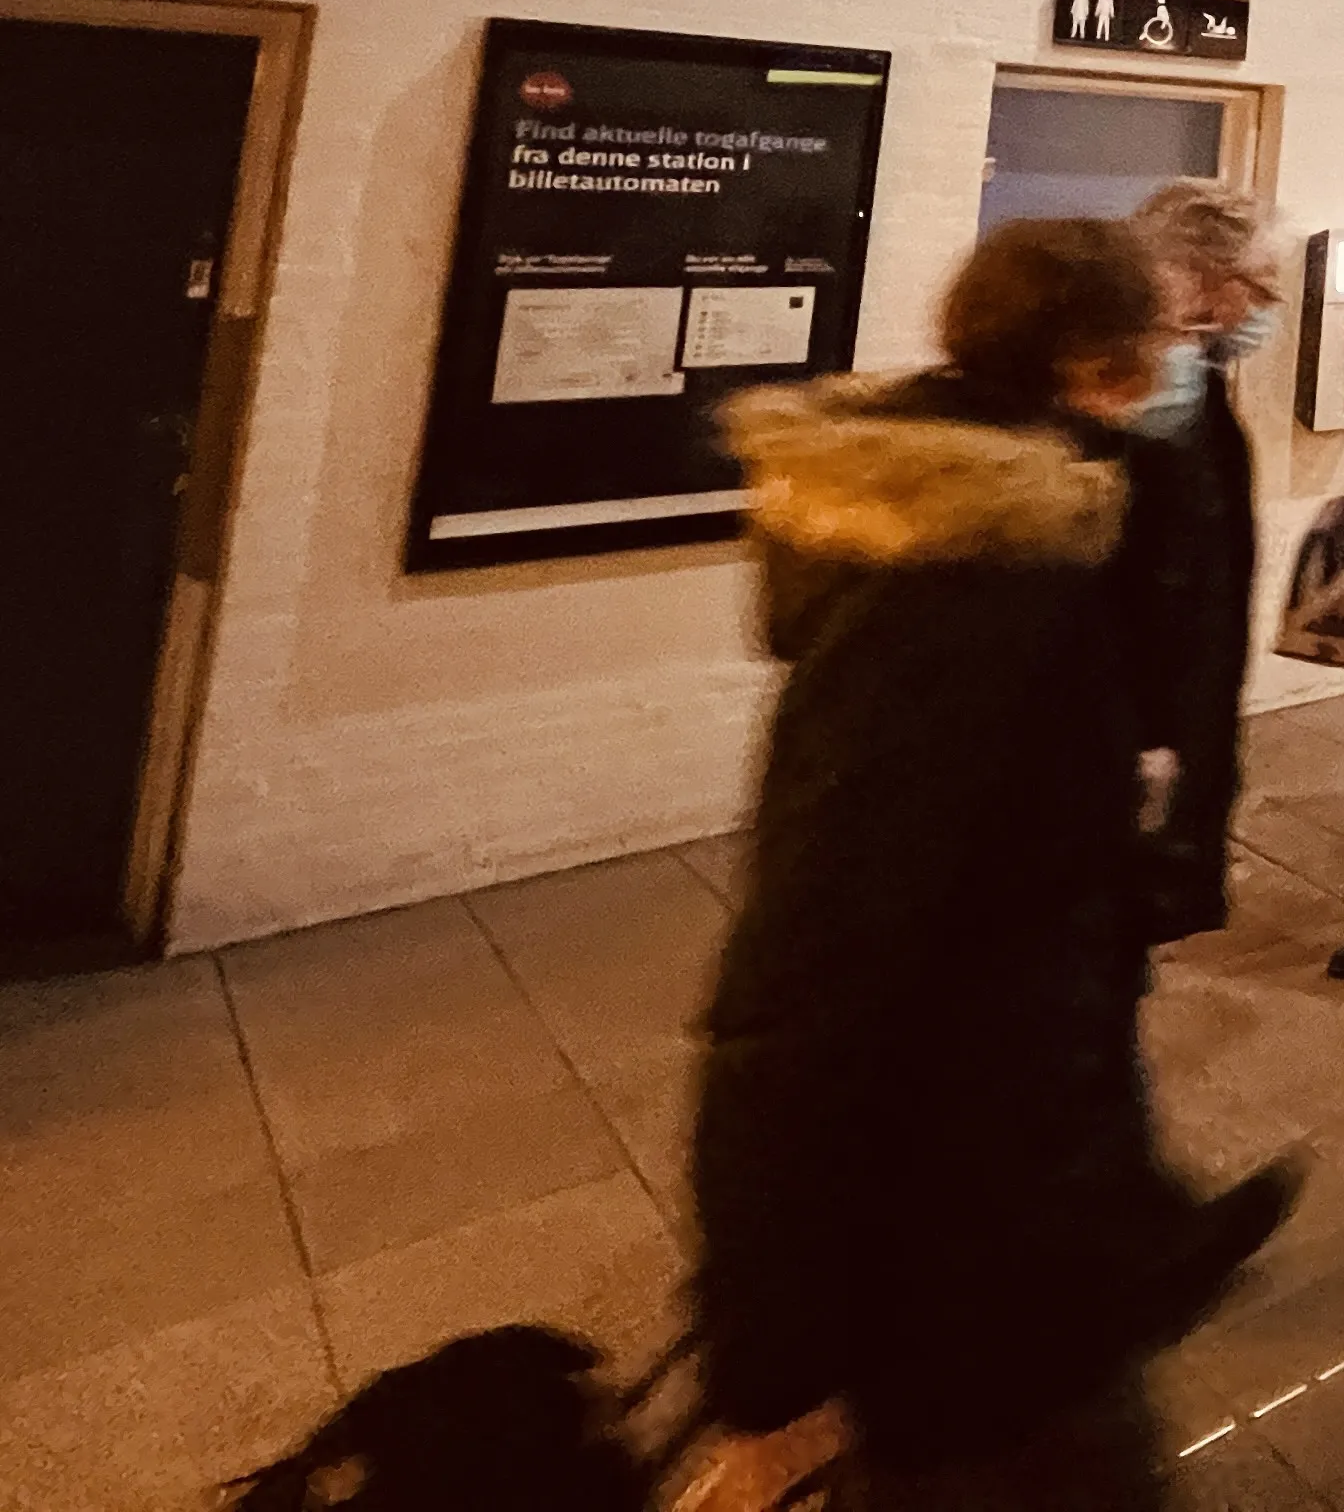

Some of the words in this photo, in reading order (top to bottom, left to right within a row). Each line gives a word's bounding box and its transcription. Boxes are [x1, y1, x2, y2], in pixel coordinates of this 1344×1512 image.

[515, 119, 576, 141] Find
[582, 125, 688, 146] aktuelle
[695, 131, 828, 153] togafgange
[512, 144, 550, 165] fra
[558, 147, 641, 168] denne
[648, 152, 735, 171] station
[508, 169, 721, 193] billetautomaten
